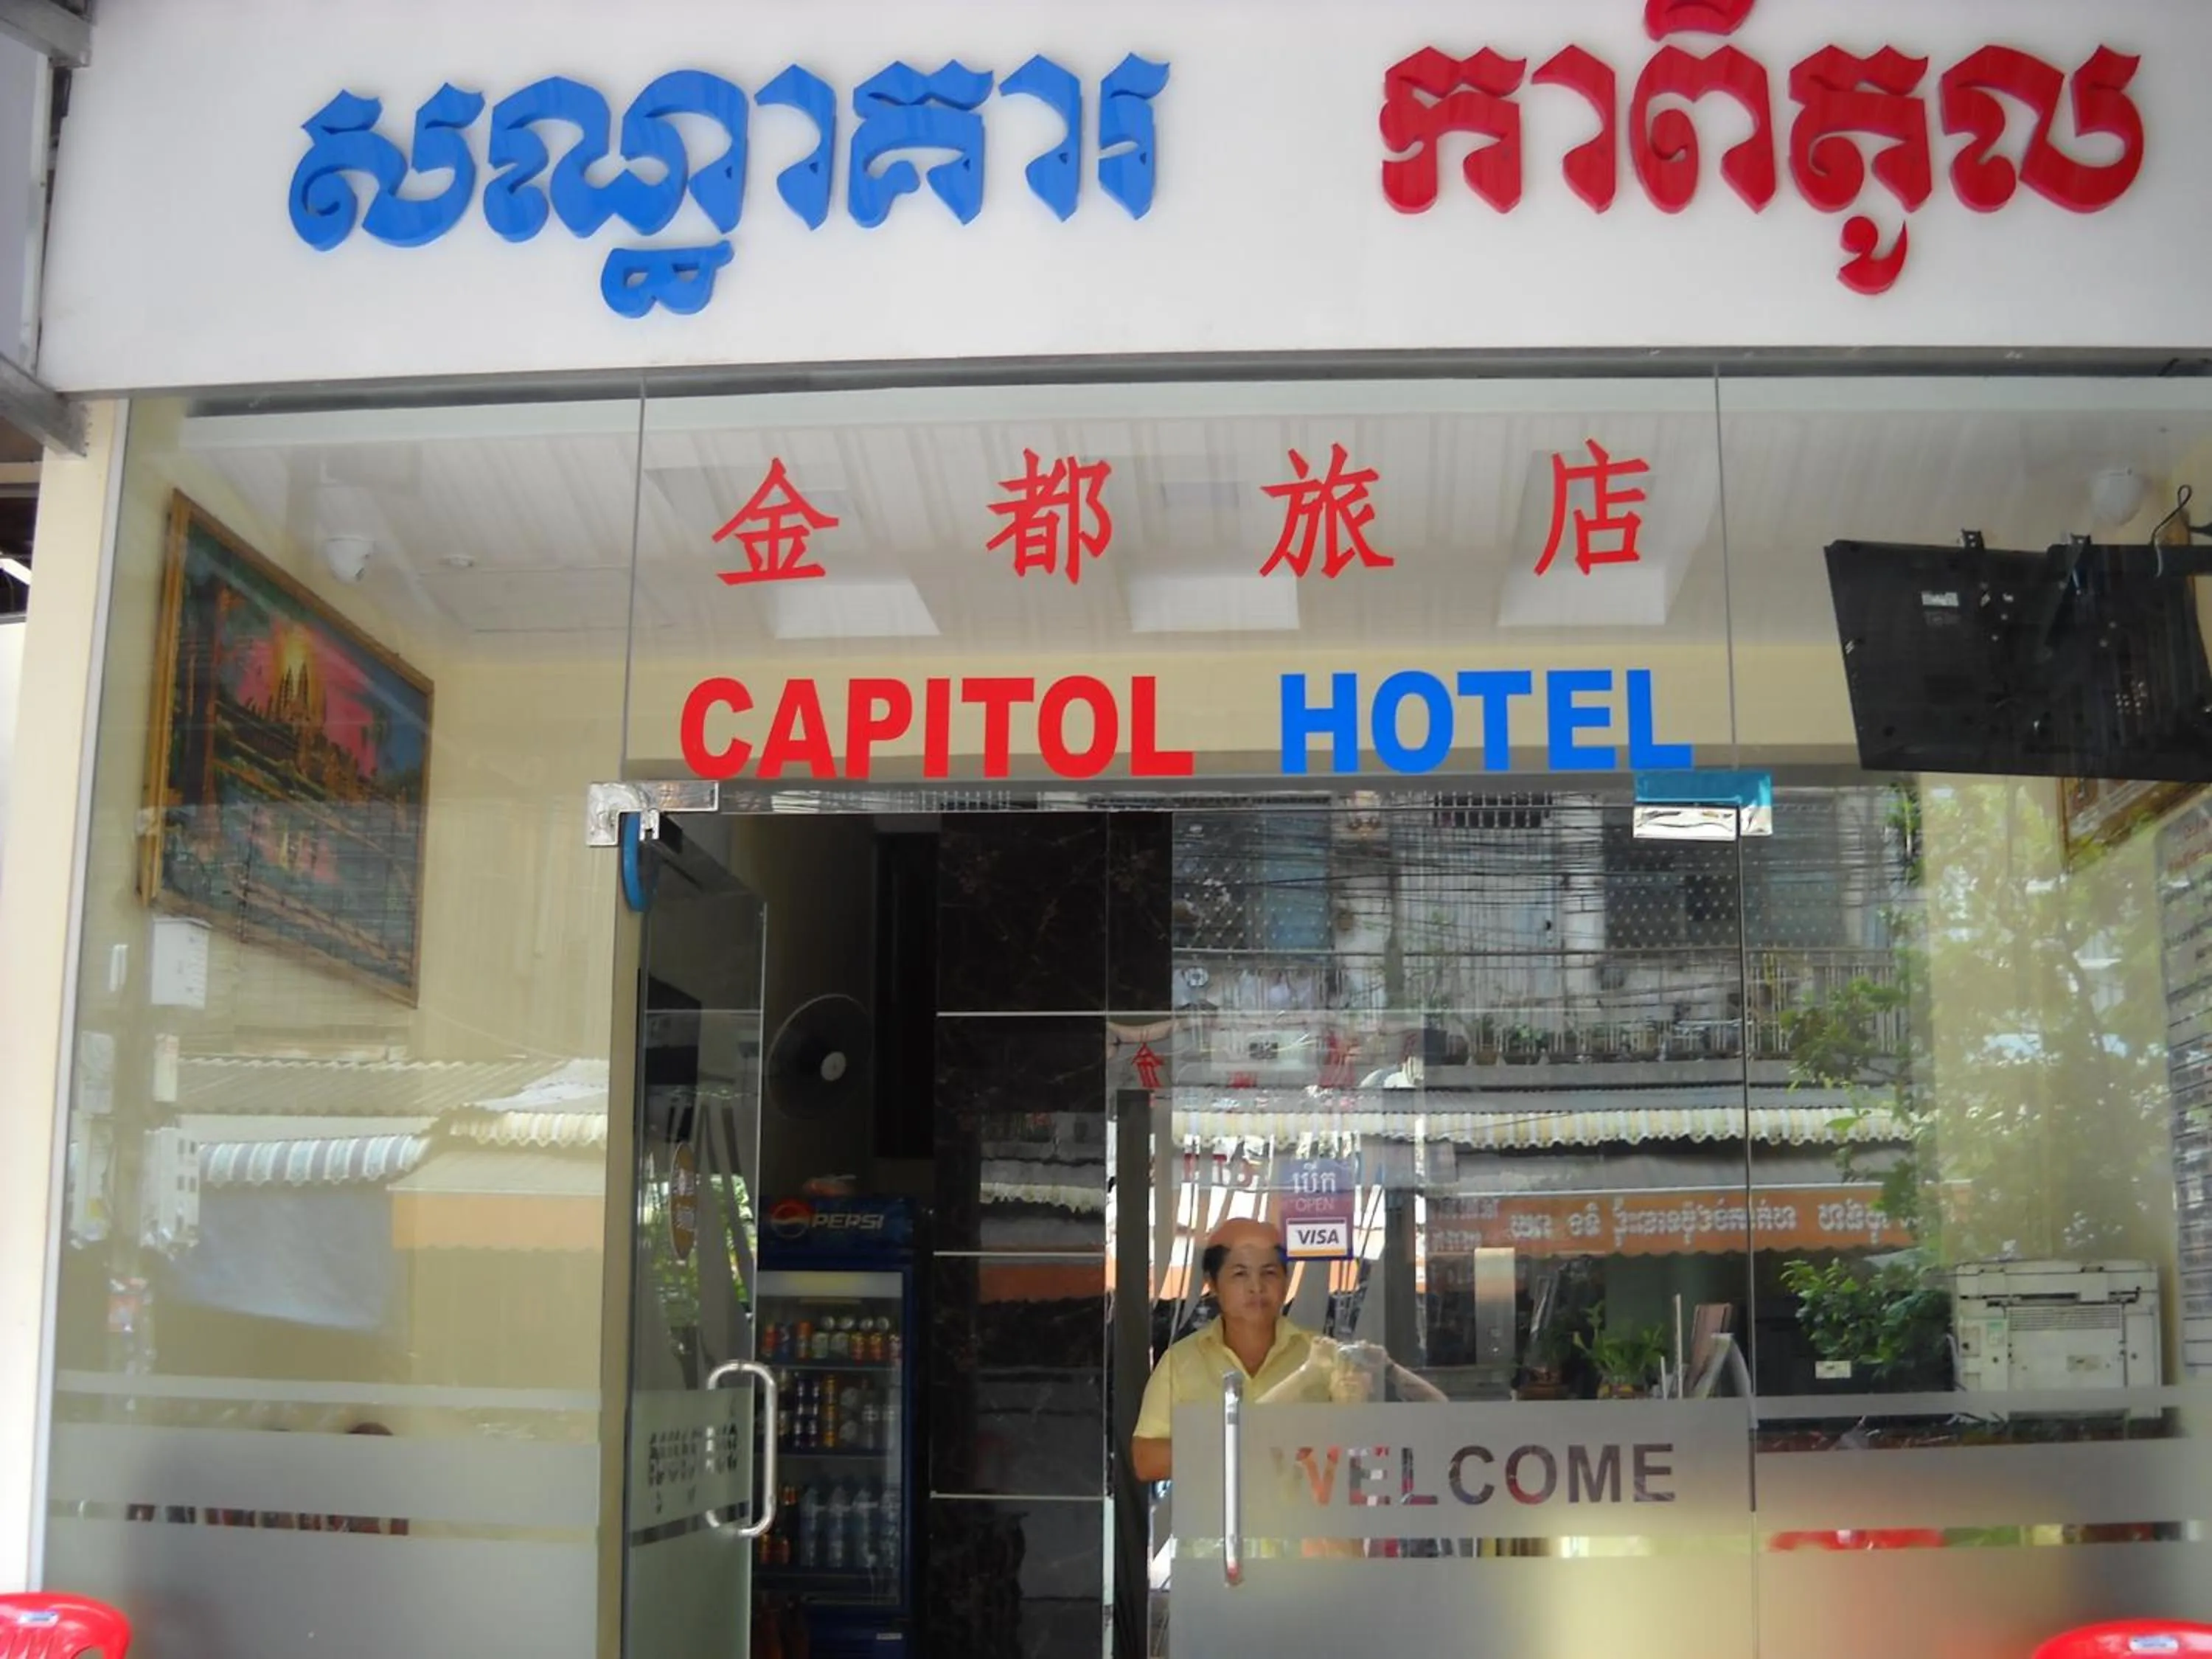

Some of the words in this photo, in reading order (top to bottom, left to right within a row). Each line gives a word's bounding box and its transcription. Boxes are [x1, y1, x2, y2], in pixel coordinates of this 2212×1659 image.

[712, 439, 1650, 587] 金都旅店
[680, 673, 1195, 781] CAPITOL
[1279, 668, 1693, 775] HOTEL
[812, 1213, 885, 1230] PEPSI
[1295, 1197, 1335, 1211] OPEN
[1298, 1229, 1340, 1245] VISA
[1270, 1442, 1677, 1506] WELCOME
